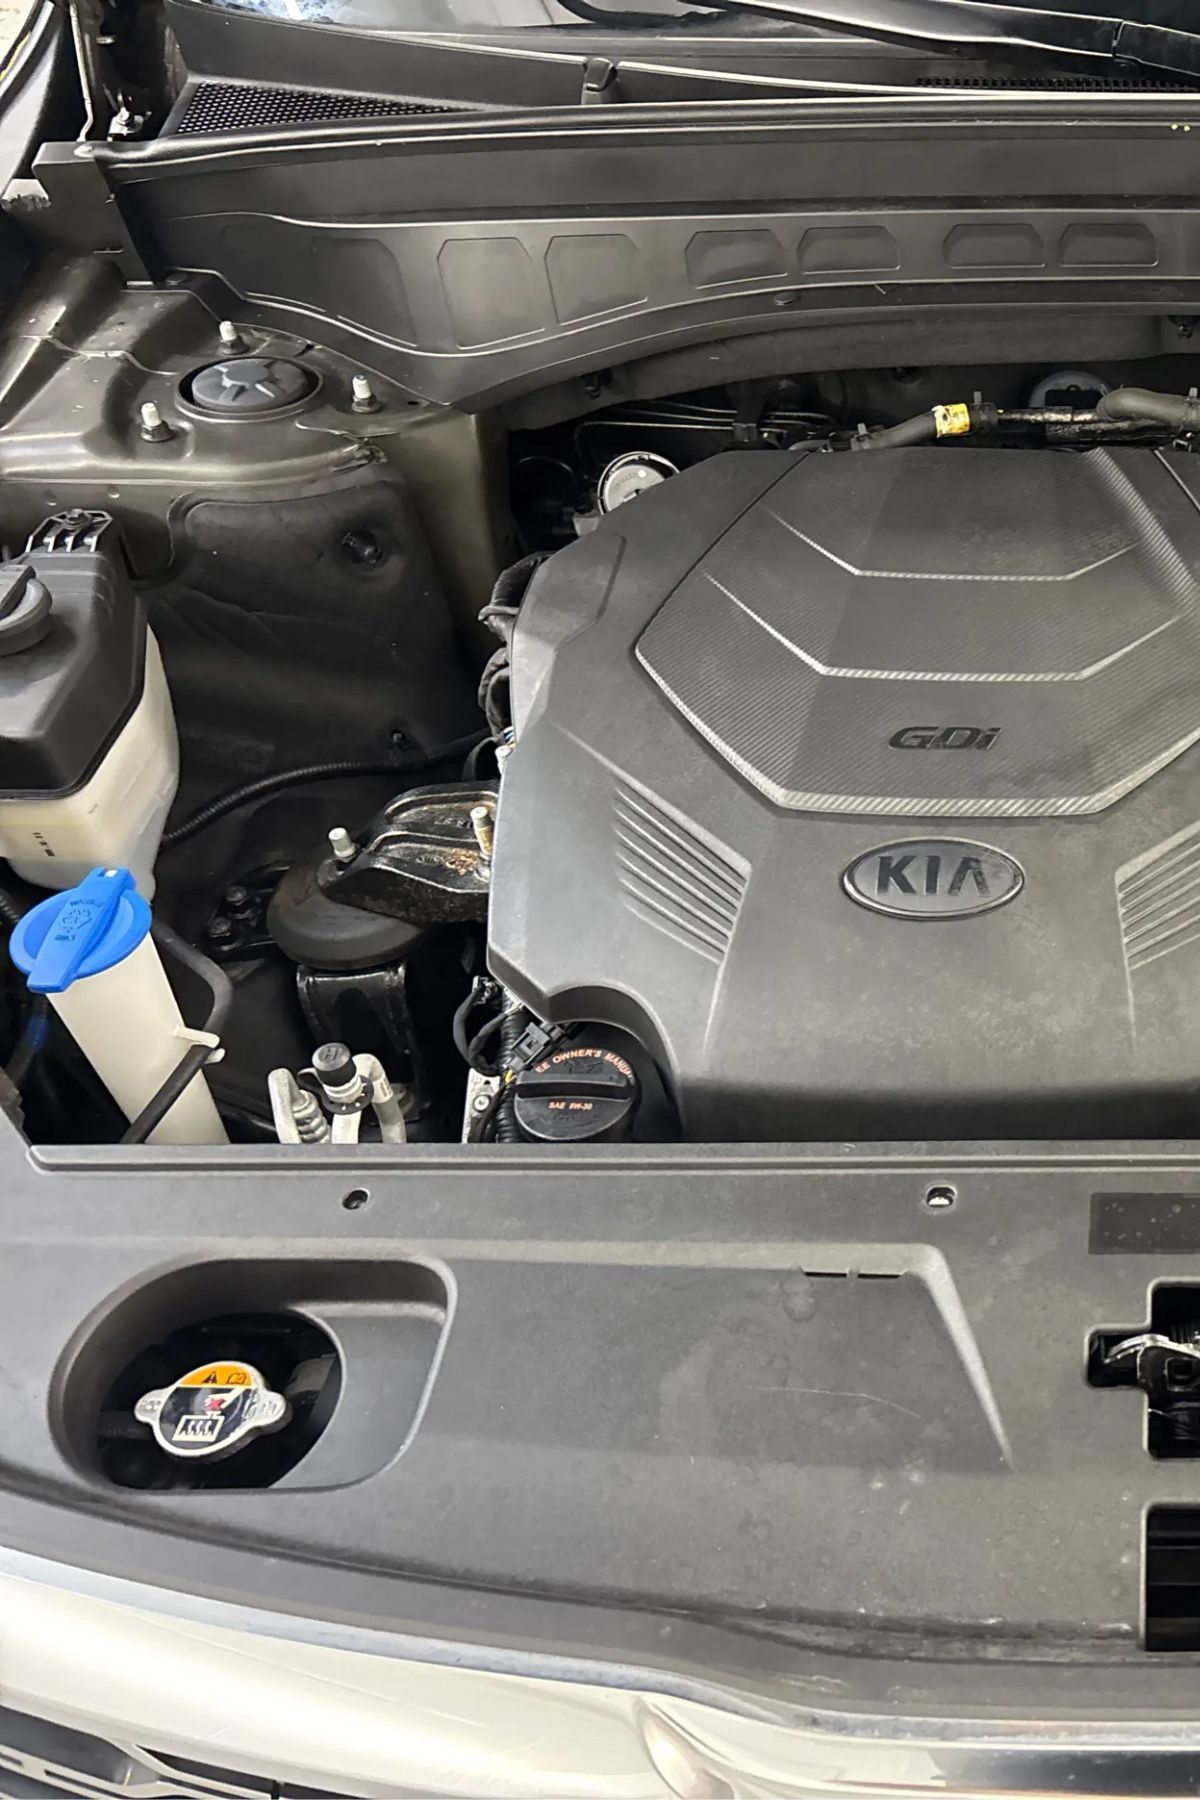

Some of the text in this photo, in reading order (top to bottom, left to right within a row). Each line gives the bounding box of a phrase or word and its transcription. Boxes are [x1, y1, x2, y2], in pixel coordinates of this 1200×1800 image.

[888, 726, 1002, 750] GDi
[876, 855, 991, 897] KIA
[535, 1061, 551, 1074] EE
[552, 1048, 602, 1064] OWNER'S
[548, 1101, 566, 1110] SAE
